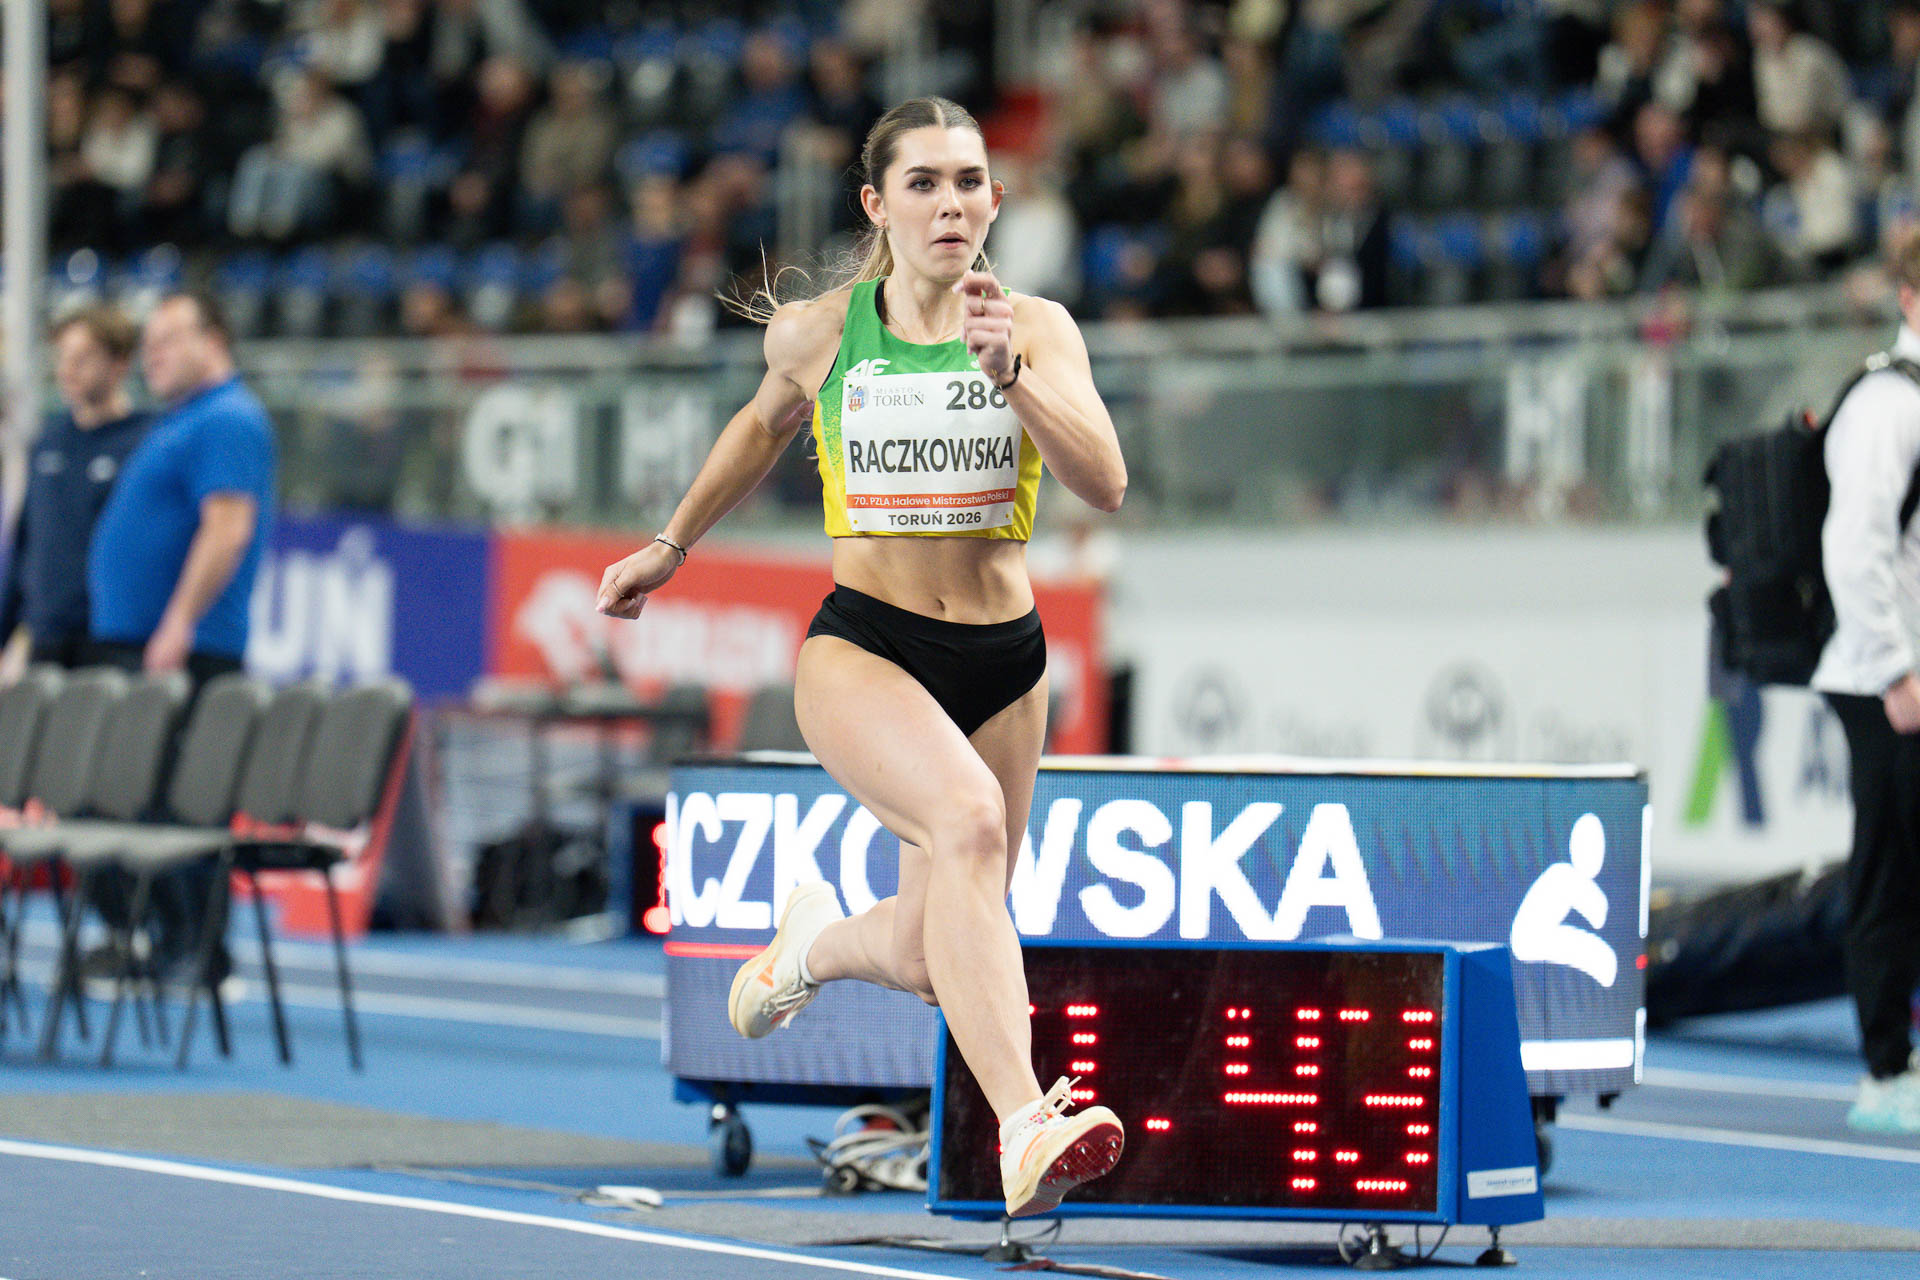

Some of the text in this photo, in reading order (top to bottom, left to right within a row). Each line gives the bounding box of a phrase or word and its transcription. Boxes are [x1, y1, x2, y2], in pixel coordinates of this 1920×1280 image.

[849, 436, 1014, 473] RACZKOWSKA
[854, 490, 1009, 506] 70. PZLA Halowe Mistrzostwa Polski
[888, 510, 982, 526] TORUŃ 2026
